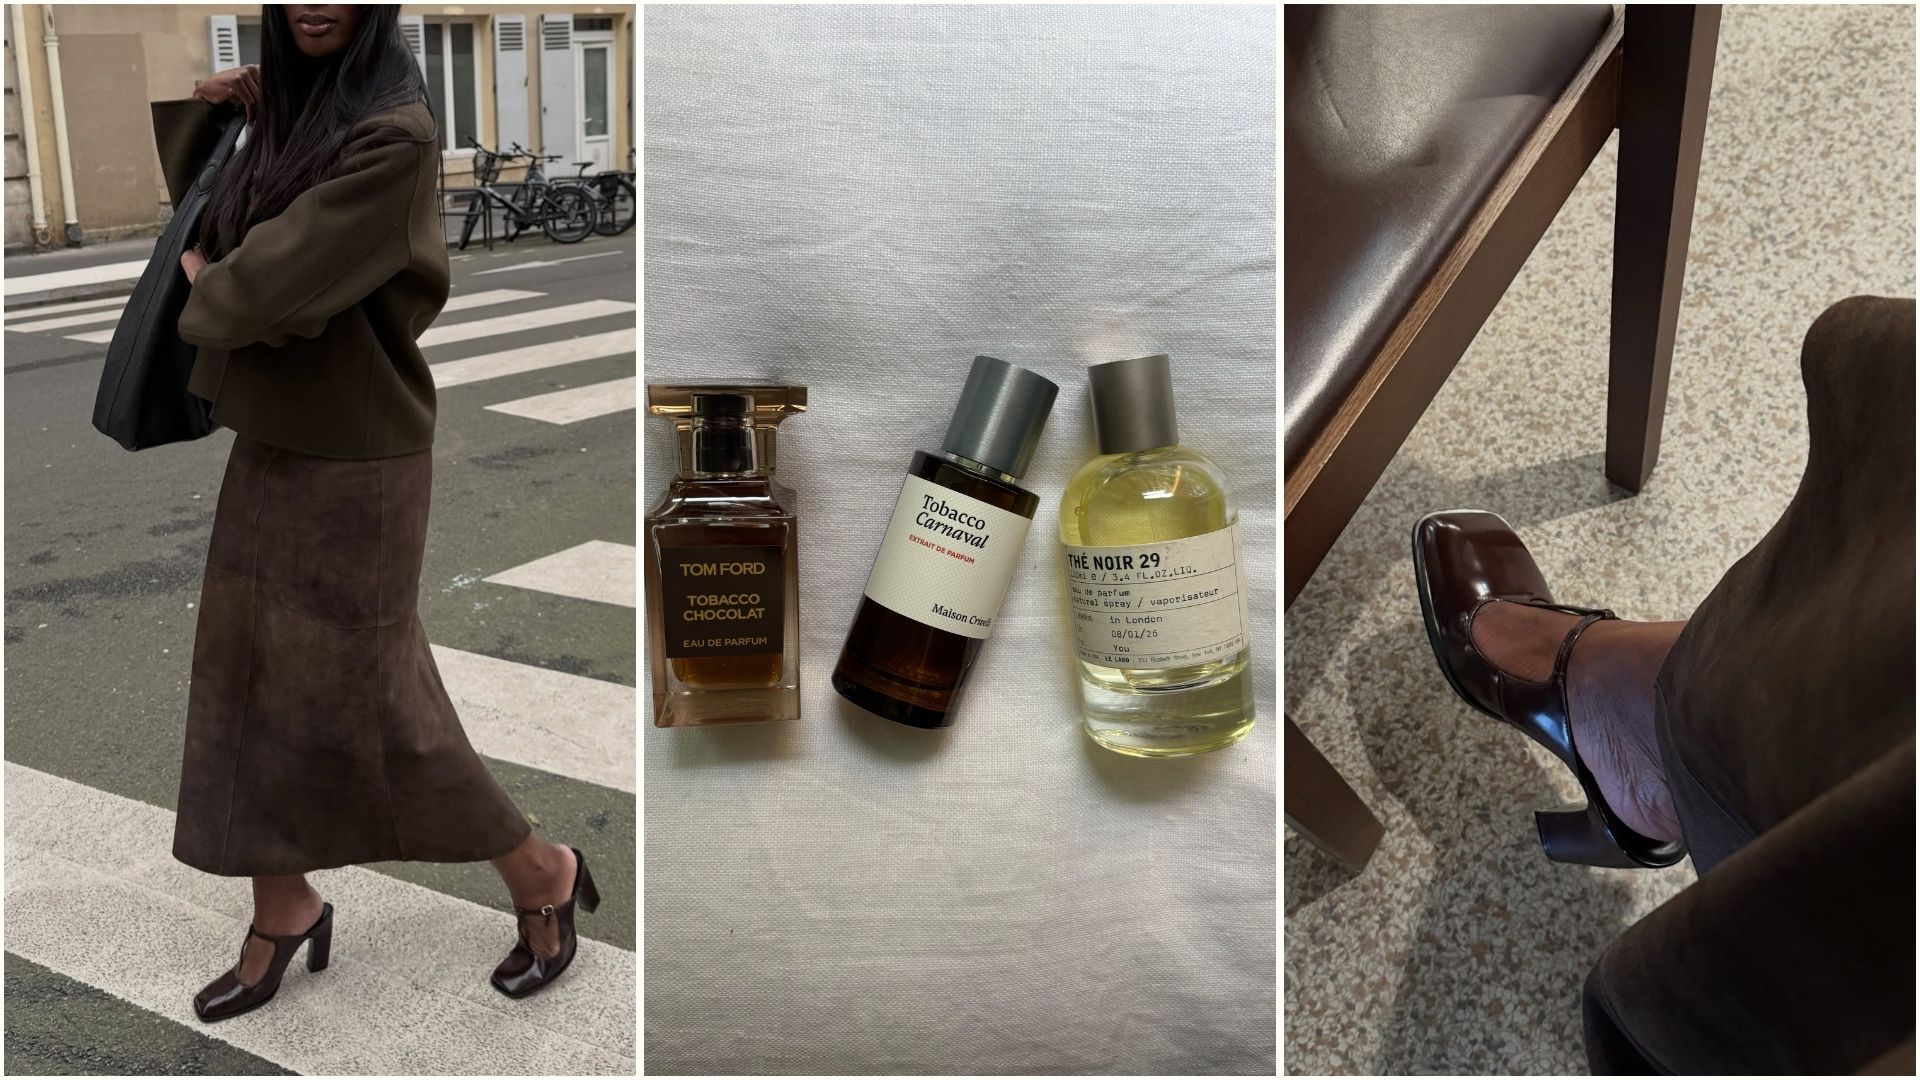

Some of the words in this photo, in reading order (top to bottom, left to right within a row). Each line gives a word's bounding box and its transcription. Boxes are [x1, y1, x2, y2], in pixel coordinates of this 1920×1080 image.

[922, 494, 986, 531] Tobacco
[916, 511, 990, 549] Carnaval
[909, 534, 935, 549] EXTRAIT
[936, 545, 946, 554] DE
[947, 550, 975, 564] PARFUM
[1068, 552, 1090, 570] THÉ
[1093, 555, 1134, 570] NOIR
[1139, 553, 1160, 569] 29
[680, 563, 717, 576] TOM
[720, 562, 765, 575] FORD
[1112, 573, 1130, 582] 3.4
[1085, 588, 1093, 596] de
[1097, 589, 1131, 597] parfum
[1103, 600, 1131, 609] spray
[1150, 588, 1219, 607] vaporisateur
[687, 593, 761, 606] TOBACCO
[683, 608, 765, 621] CHOCOLAT
[932, 603, 968, 623] Maison
[1110, 616, 1120, 624] in
[1125, 615, 1163, 624] London
[1111, 628, 1158, 639] 08/01/26
[683, 640, 705, 648] EAU
[708, 639, 722, 647] DE
[725, 637, 767, 647] PARFUM
[1113, 644, 1130, 653] You
